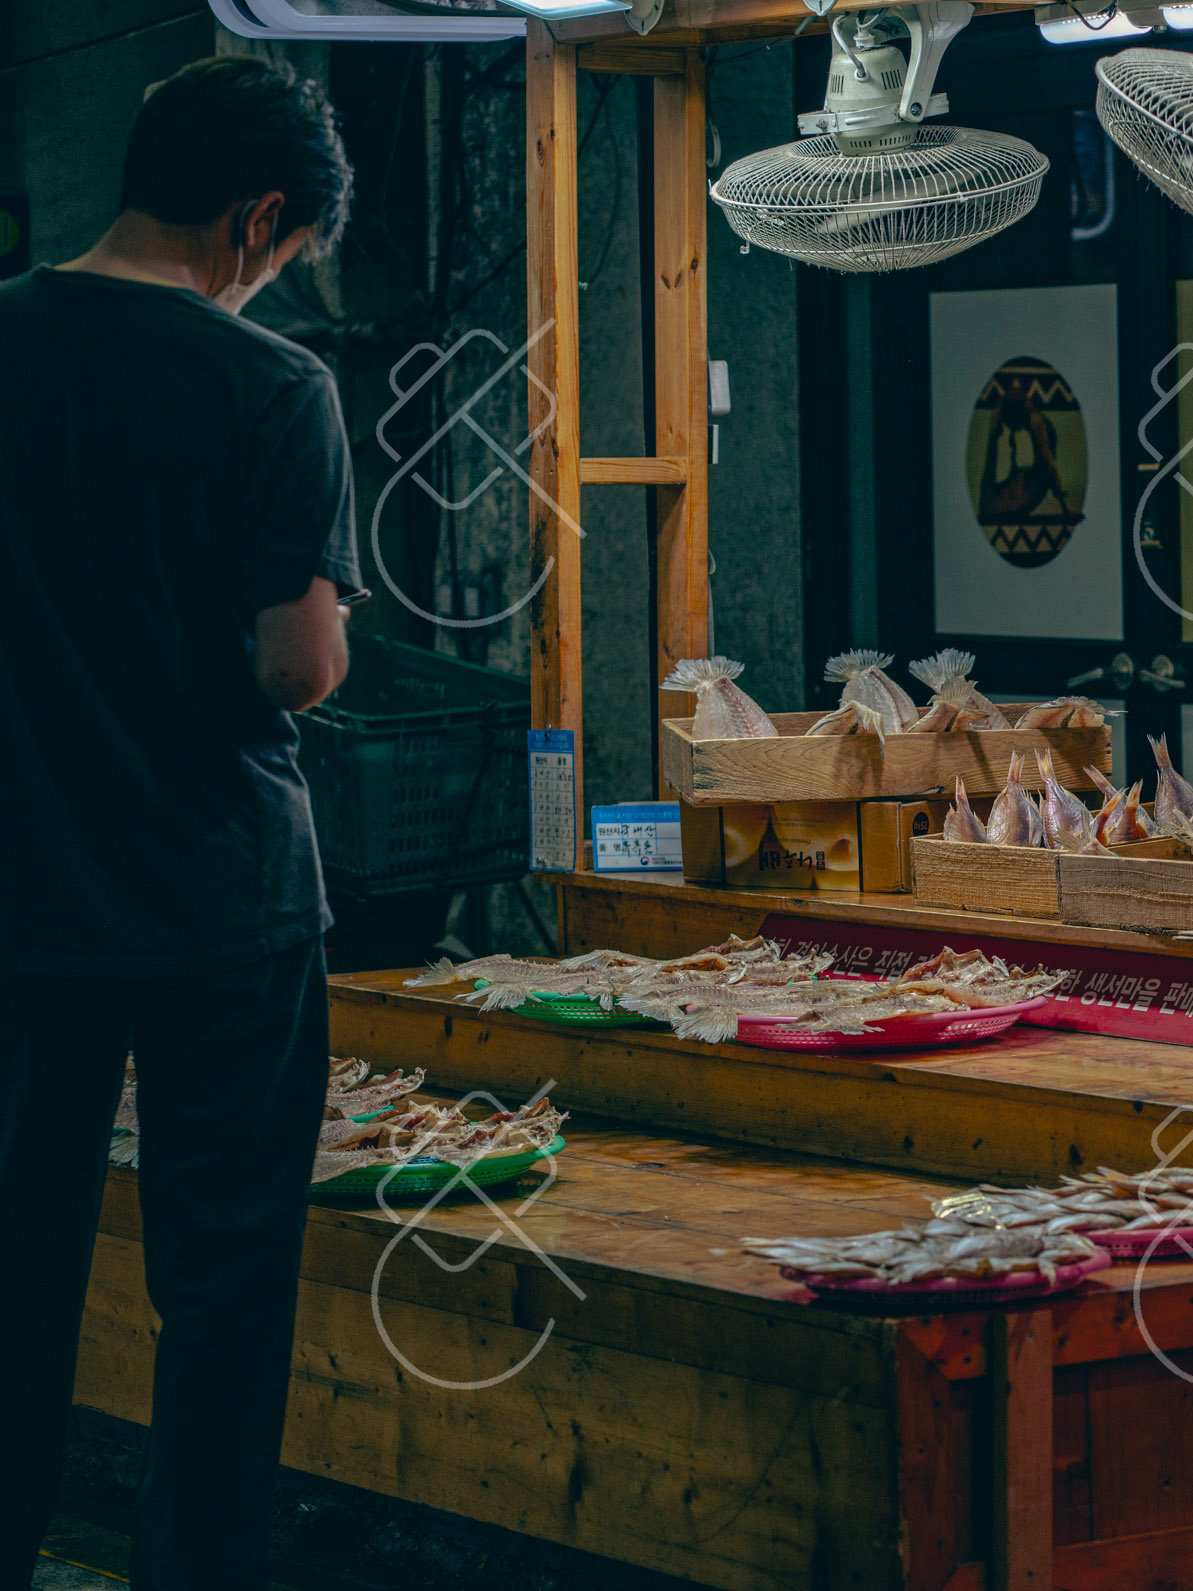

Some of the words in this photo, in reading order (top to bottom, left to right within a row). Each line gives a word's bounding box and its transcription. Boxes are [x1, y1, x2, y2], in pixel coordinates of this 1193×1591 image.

[758, 841, 813, 871] 나주배
[874, 949, 914, 981] 직접
[1080, 971, 1162, 1012] 생선만을
